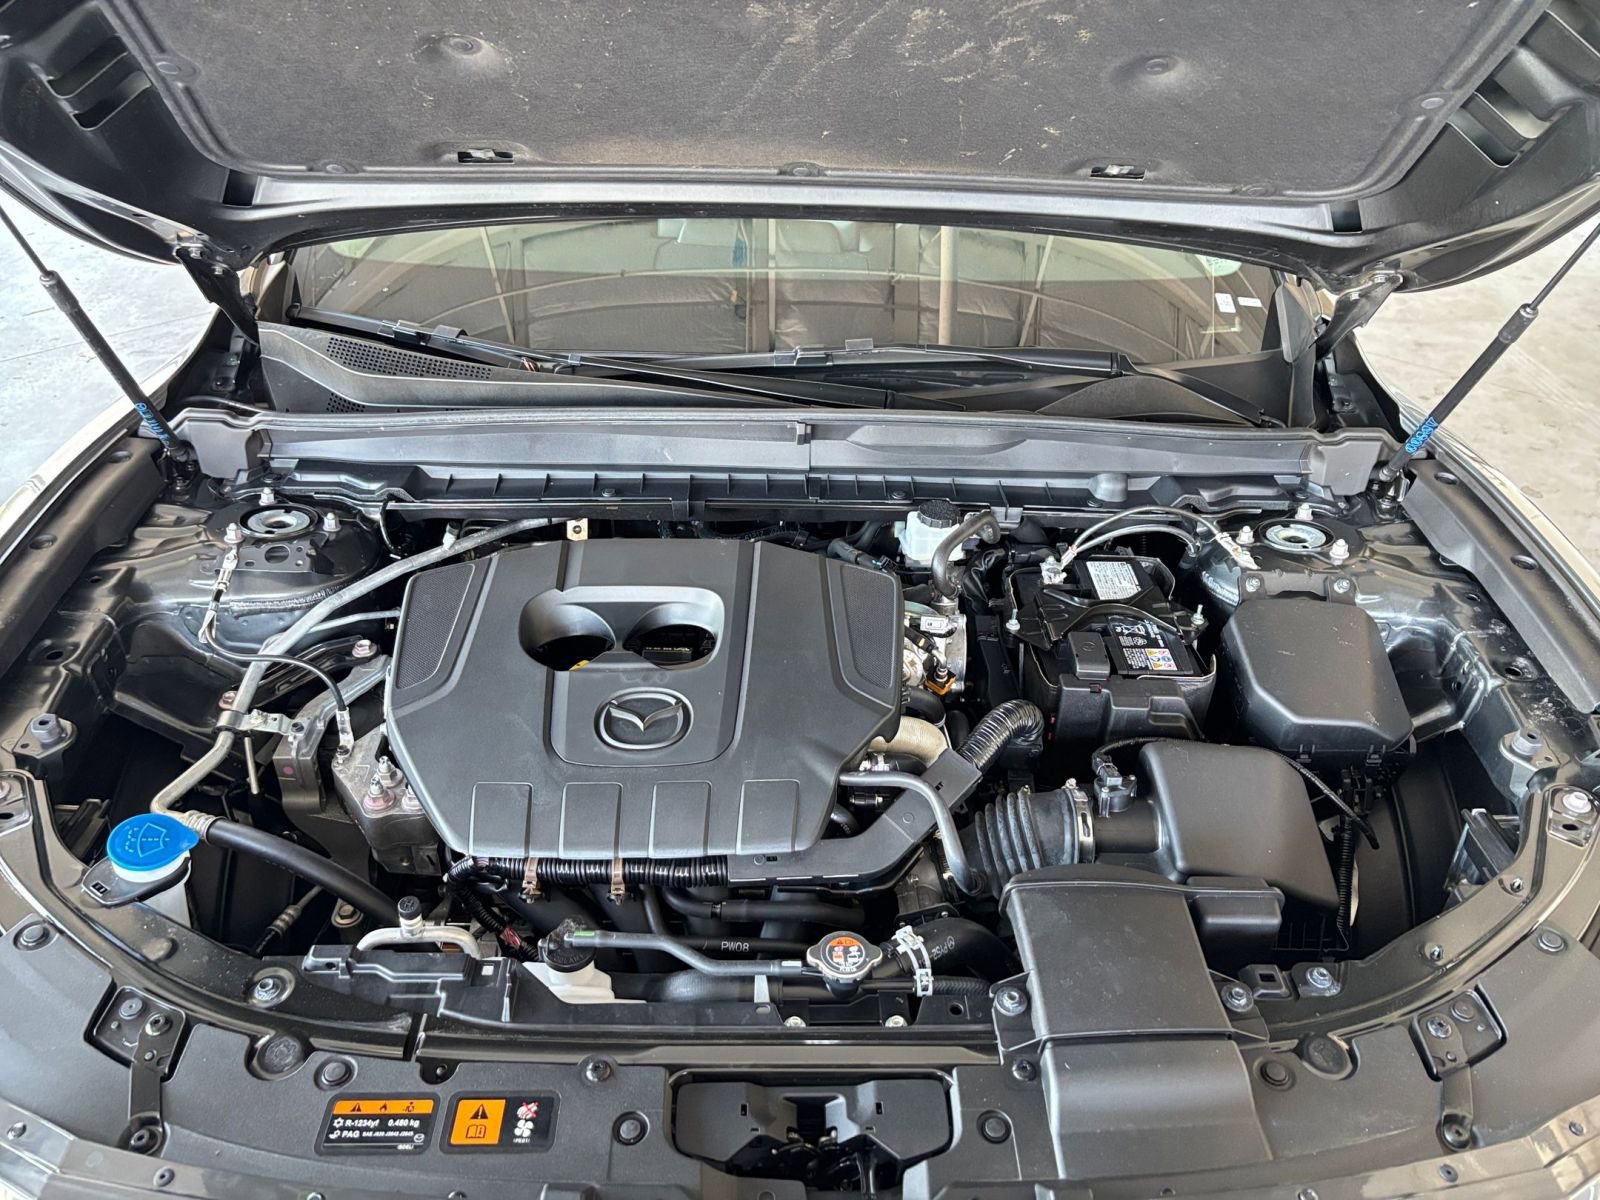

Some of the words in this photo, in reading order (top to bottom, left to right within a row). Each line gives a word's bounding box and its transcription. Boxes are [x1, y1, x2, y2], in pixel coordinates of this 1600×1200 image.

[721, 941, 750, 952] PW08
[345, 1119, 380, 1128] R-1234yf
[409, 1119, 420, 1128] kg
[342, 1130, 360, 1138] PAG
